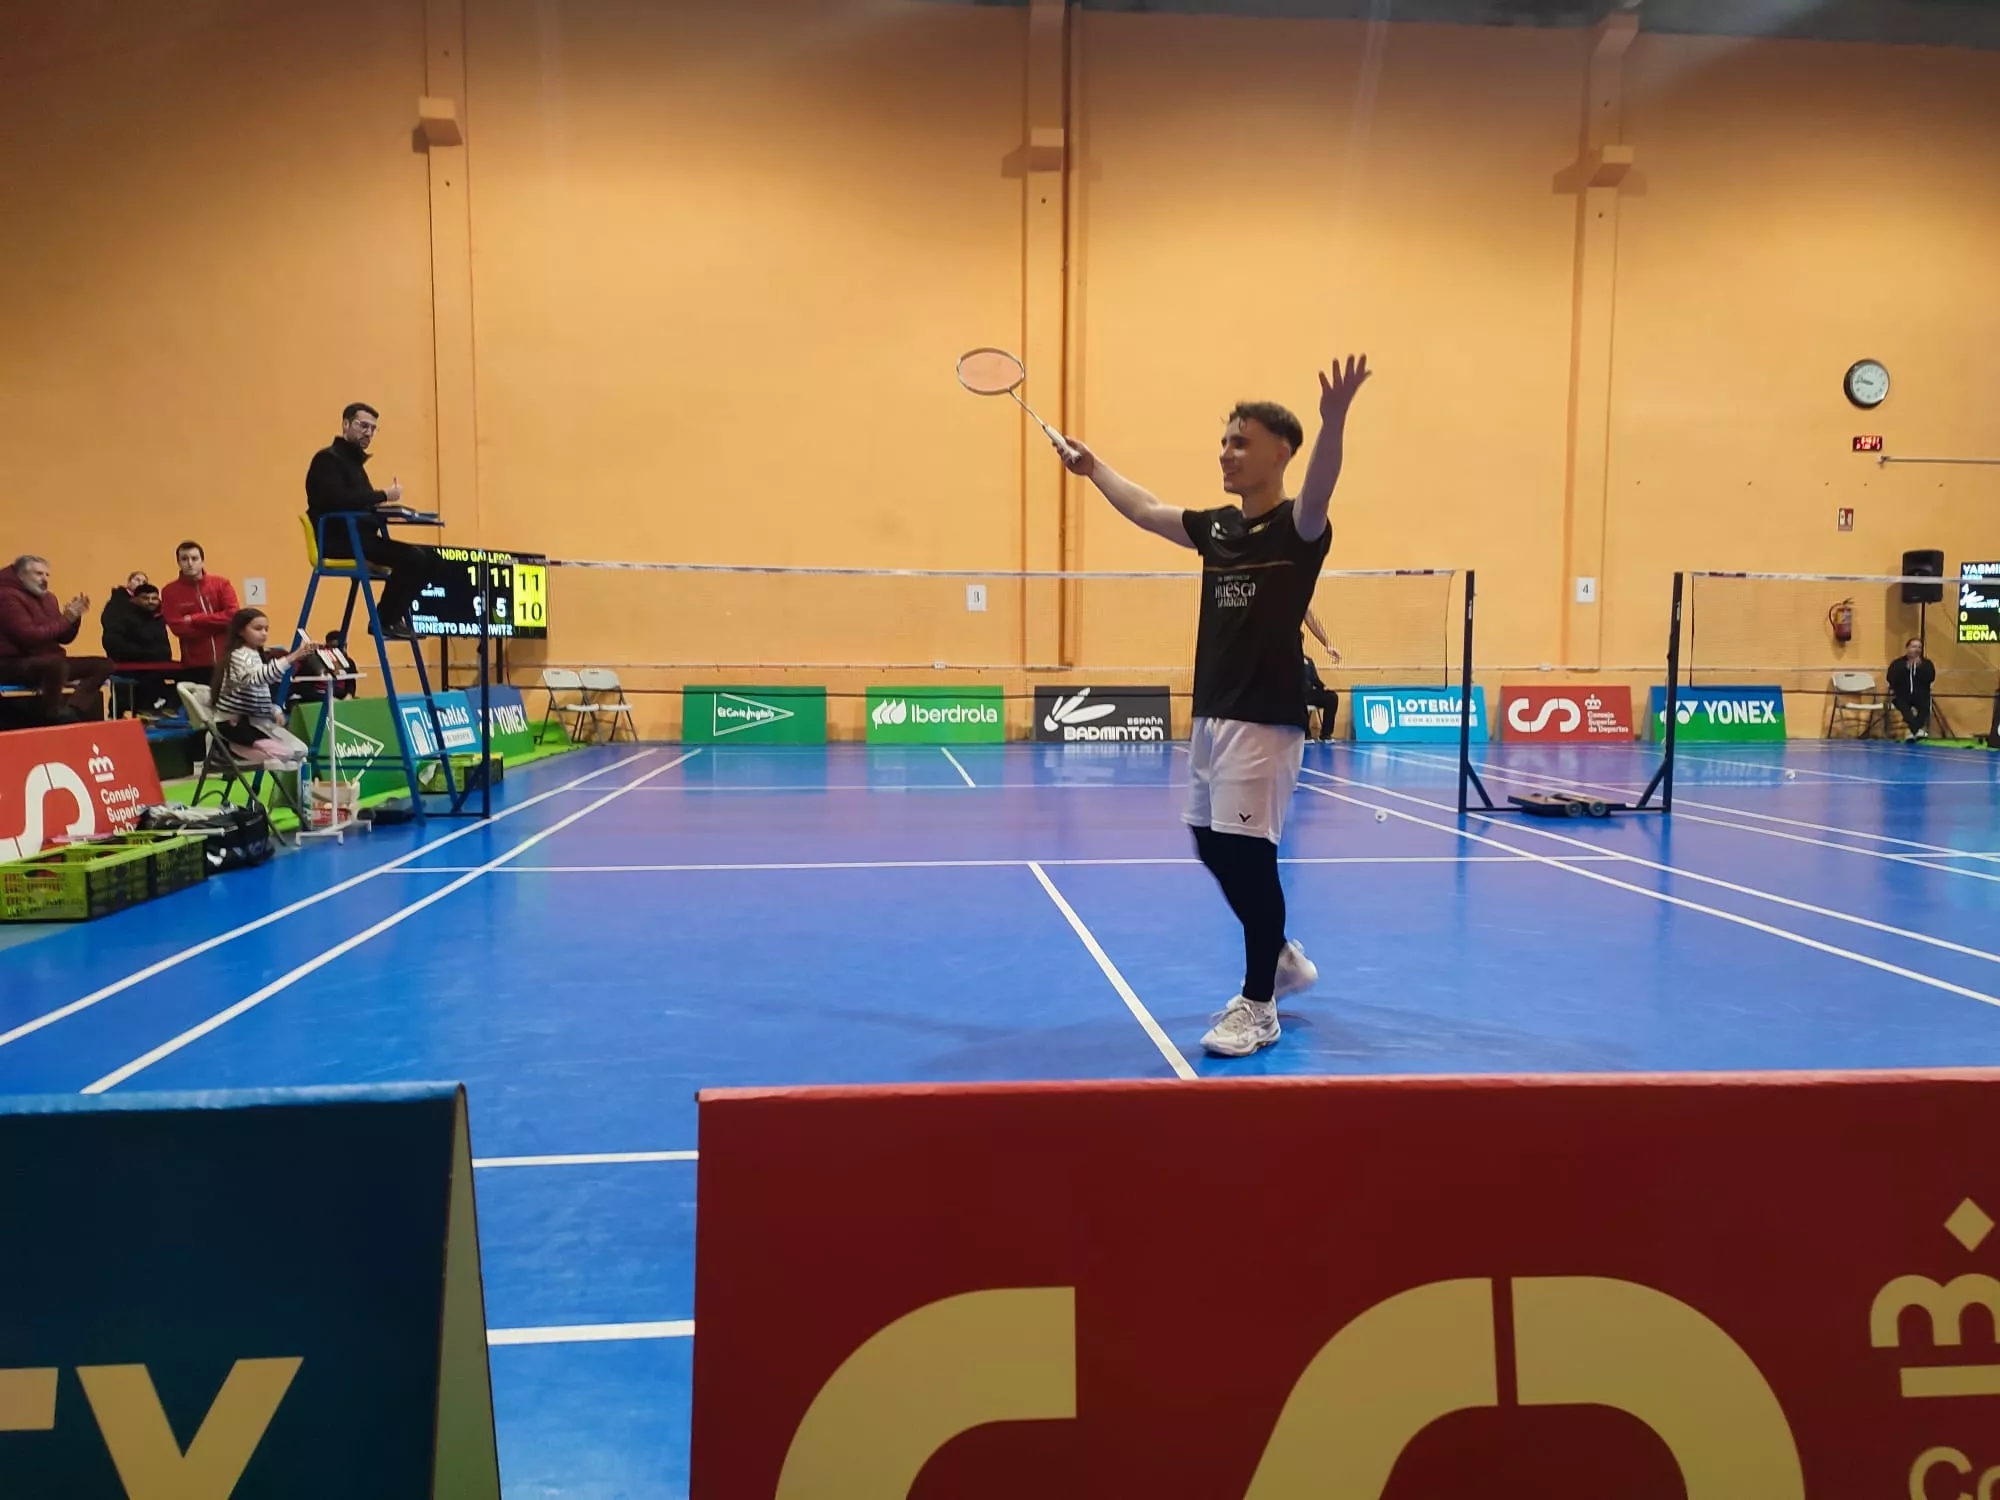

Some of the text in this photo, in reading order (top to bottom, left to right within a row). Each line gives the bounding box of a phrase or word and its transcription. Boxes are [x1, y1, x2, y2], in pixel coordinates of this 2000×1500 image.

[490, 567, 510, 588] 11
[519, 572, 540, 592] 11
[496, 597, 507, 618] 5
[519, 601, 543, 622] 10
[494, 704, 528, 736] YONEX
[911, 703, 998, 723] Iberdrola
[1703, 700, 1777, 725] YONEX
[1063, 725, 1164, 741] BADMINTON
[101, 784, 139, 805] Consejo
